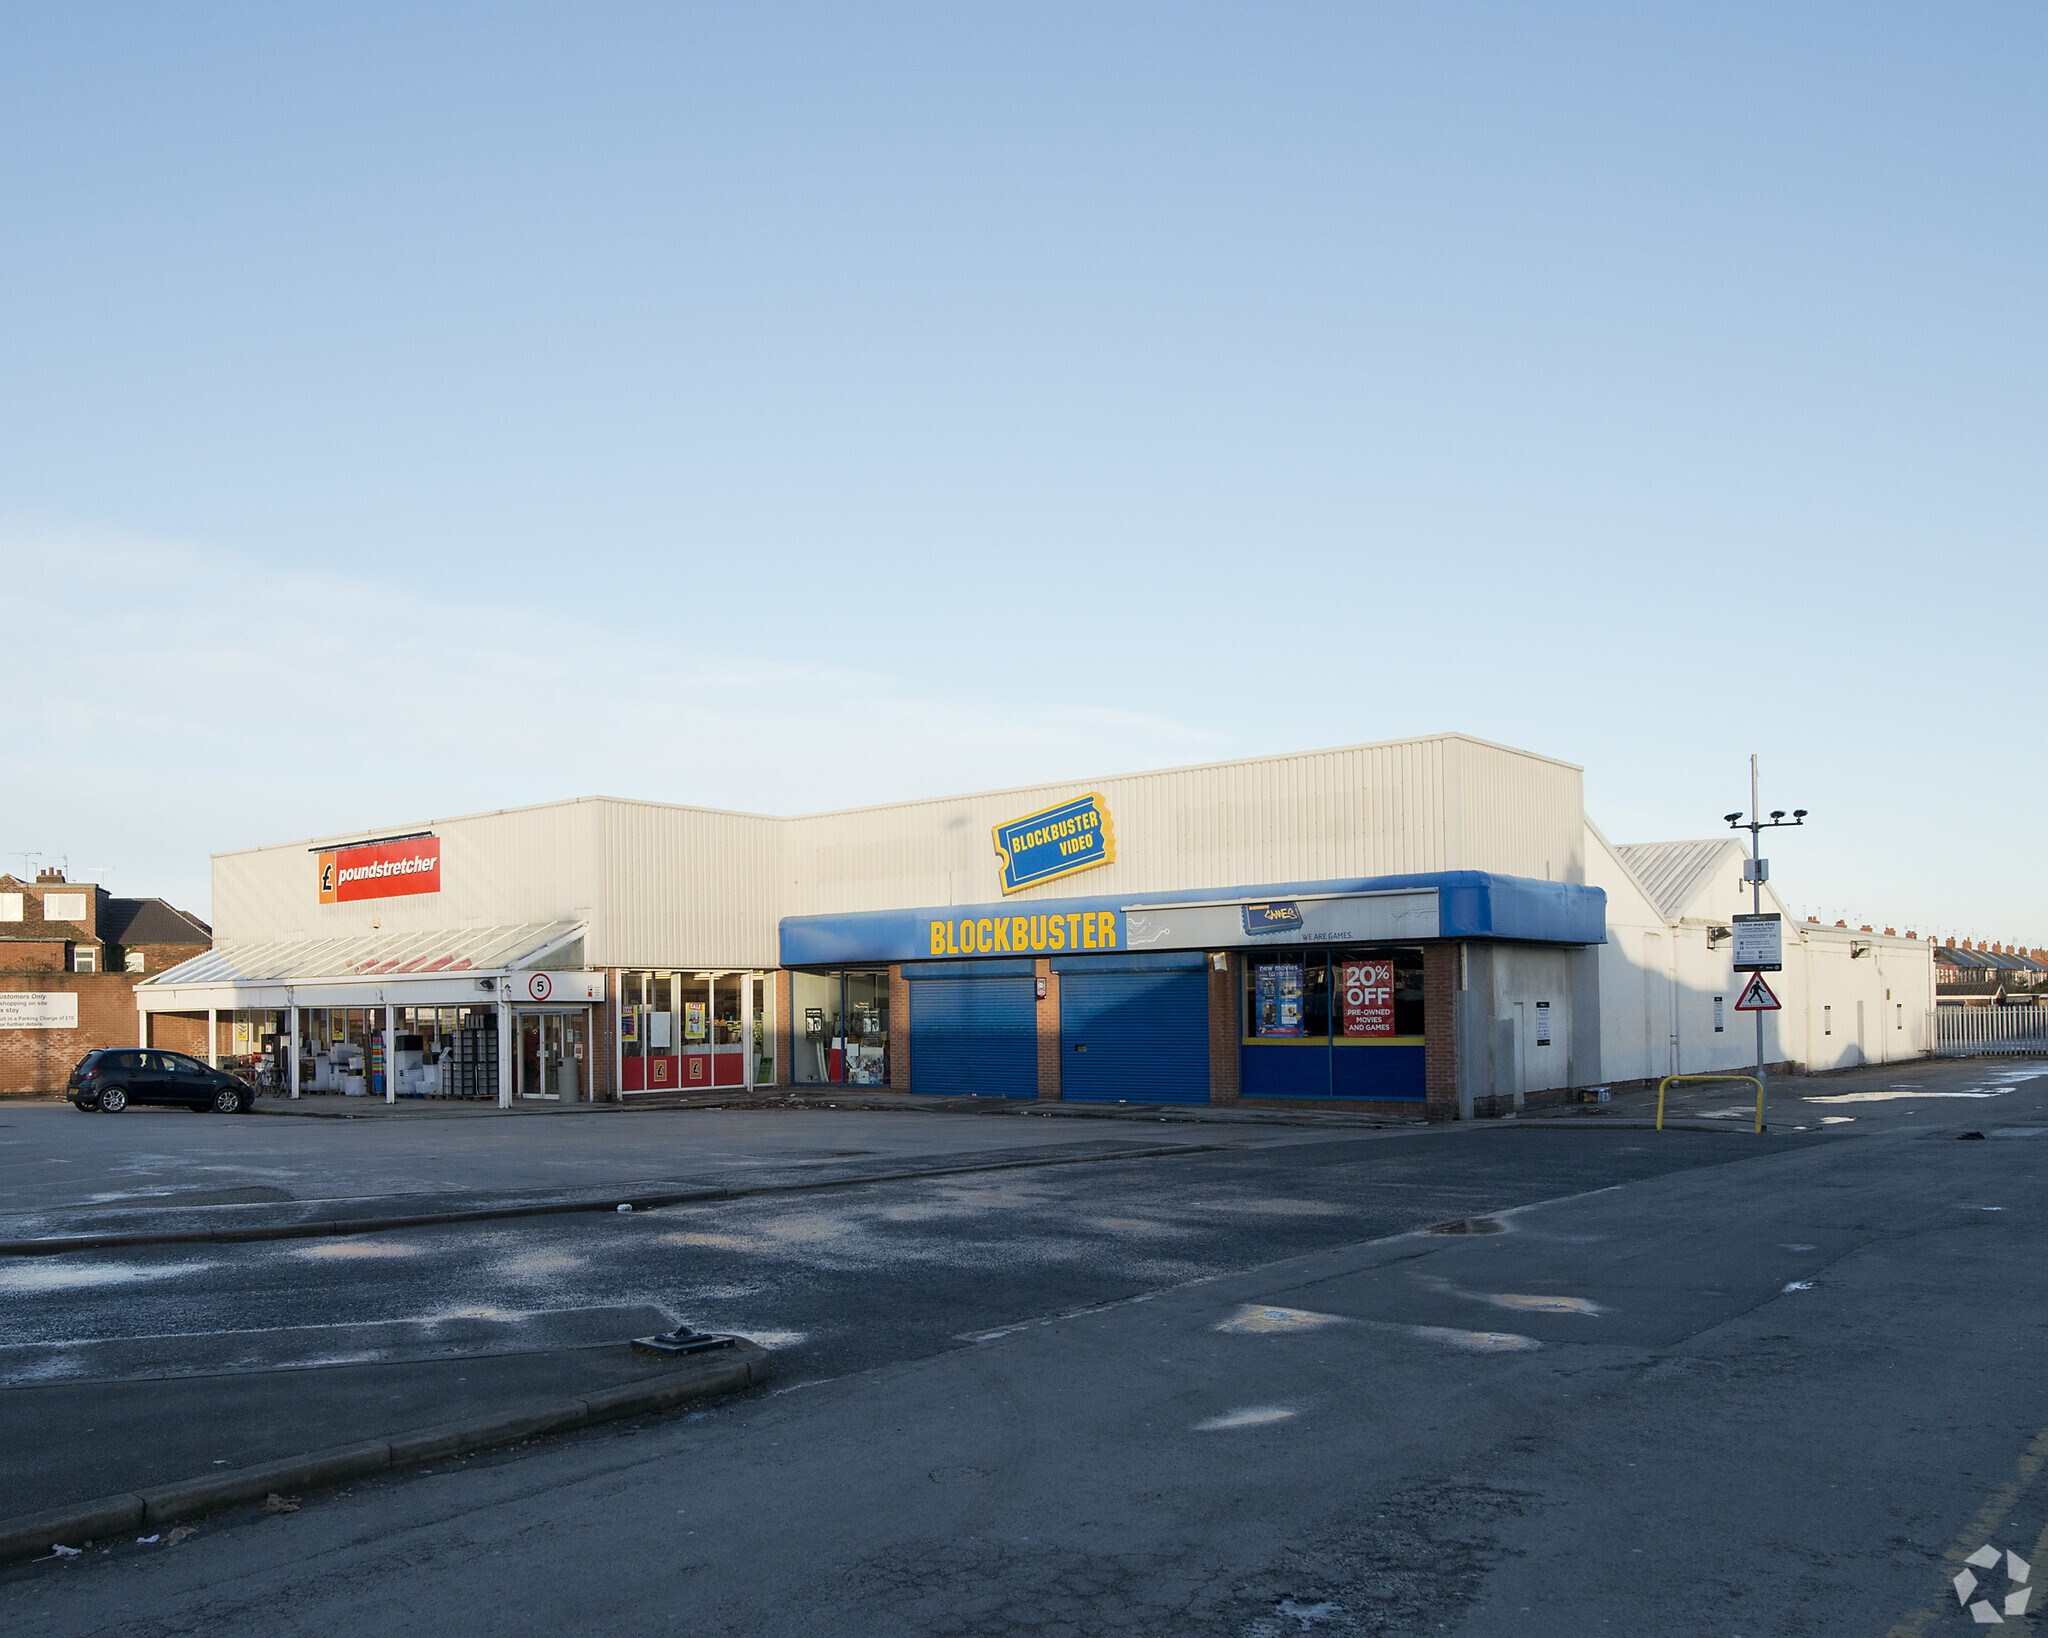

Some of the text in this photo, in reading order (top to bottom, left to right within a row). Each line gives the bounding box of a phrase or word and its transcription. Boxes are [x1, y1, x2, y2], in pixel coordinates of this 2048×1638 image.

[1012, 811, 1098, 853] BLOCKBUSTER
[1059, 833, 1093, 856] VIDEO
[338, 855, 437, 886] poundstretcher
[1264, 908, 1297, 920] GAMES
[930, 911, 1116, 955] BLOCKBUSTER
[536, 980, 544, 992] 5
[1346, 965, 1390, 987] 20%
[1346, 987, 1390, 1006] OFF
[1347, 1008, 1391, 1016] PRE-OWNED
